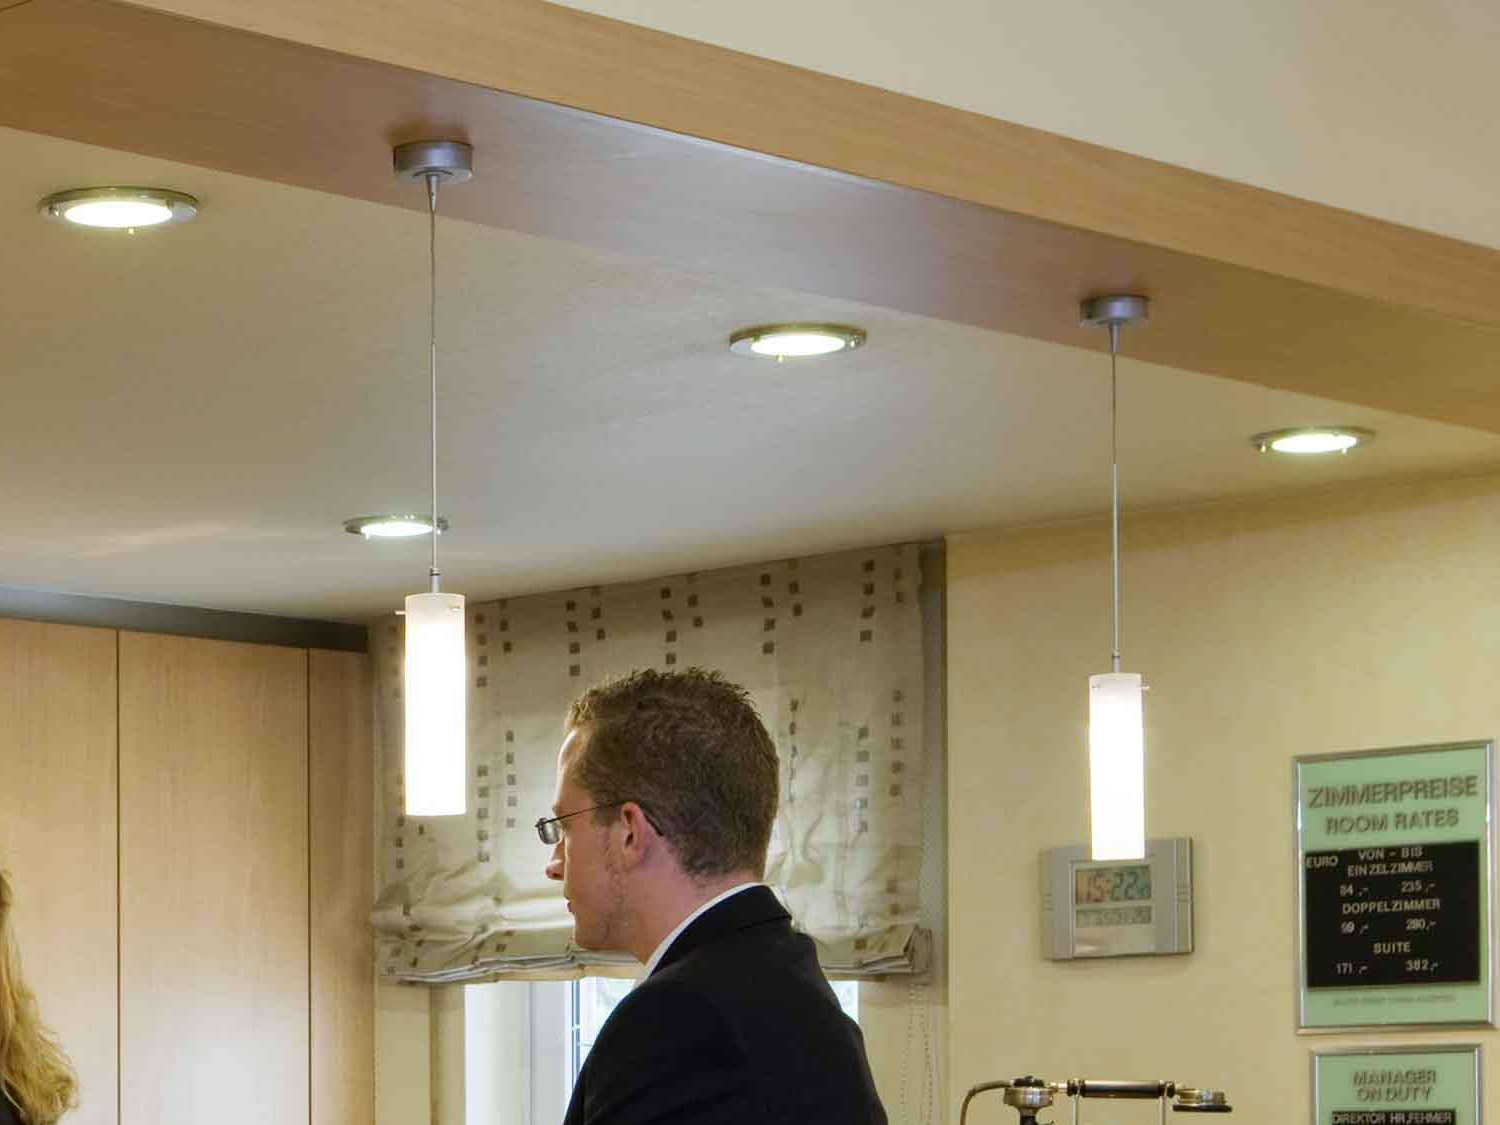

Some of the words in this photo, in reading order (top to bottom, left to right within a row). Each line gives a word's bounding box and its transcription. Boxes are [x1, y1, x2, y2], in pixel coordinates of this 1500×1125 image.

[1307, 775, 1478, 809] ZIMMERPREISE
[1324, 814, 1388, 836] ROOM
[1395, 807, 1460, 831] RATES
[1305, 855, 1340, 869] EURO
[1358, 848, 1385, 861] VON
[1341, 898, 1441, 915] DOPPELZIMMER
[1372, 941, 1412, 955] SUITE
[1353, 1070, 1437, 1086] MANAGER
[1357, 1086, 1381, 1101] ON
[1386, 1086, 1432, 1102] DUTY
[1332, 1112, 1386, 1125] DIREKTOR
